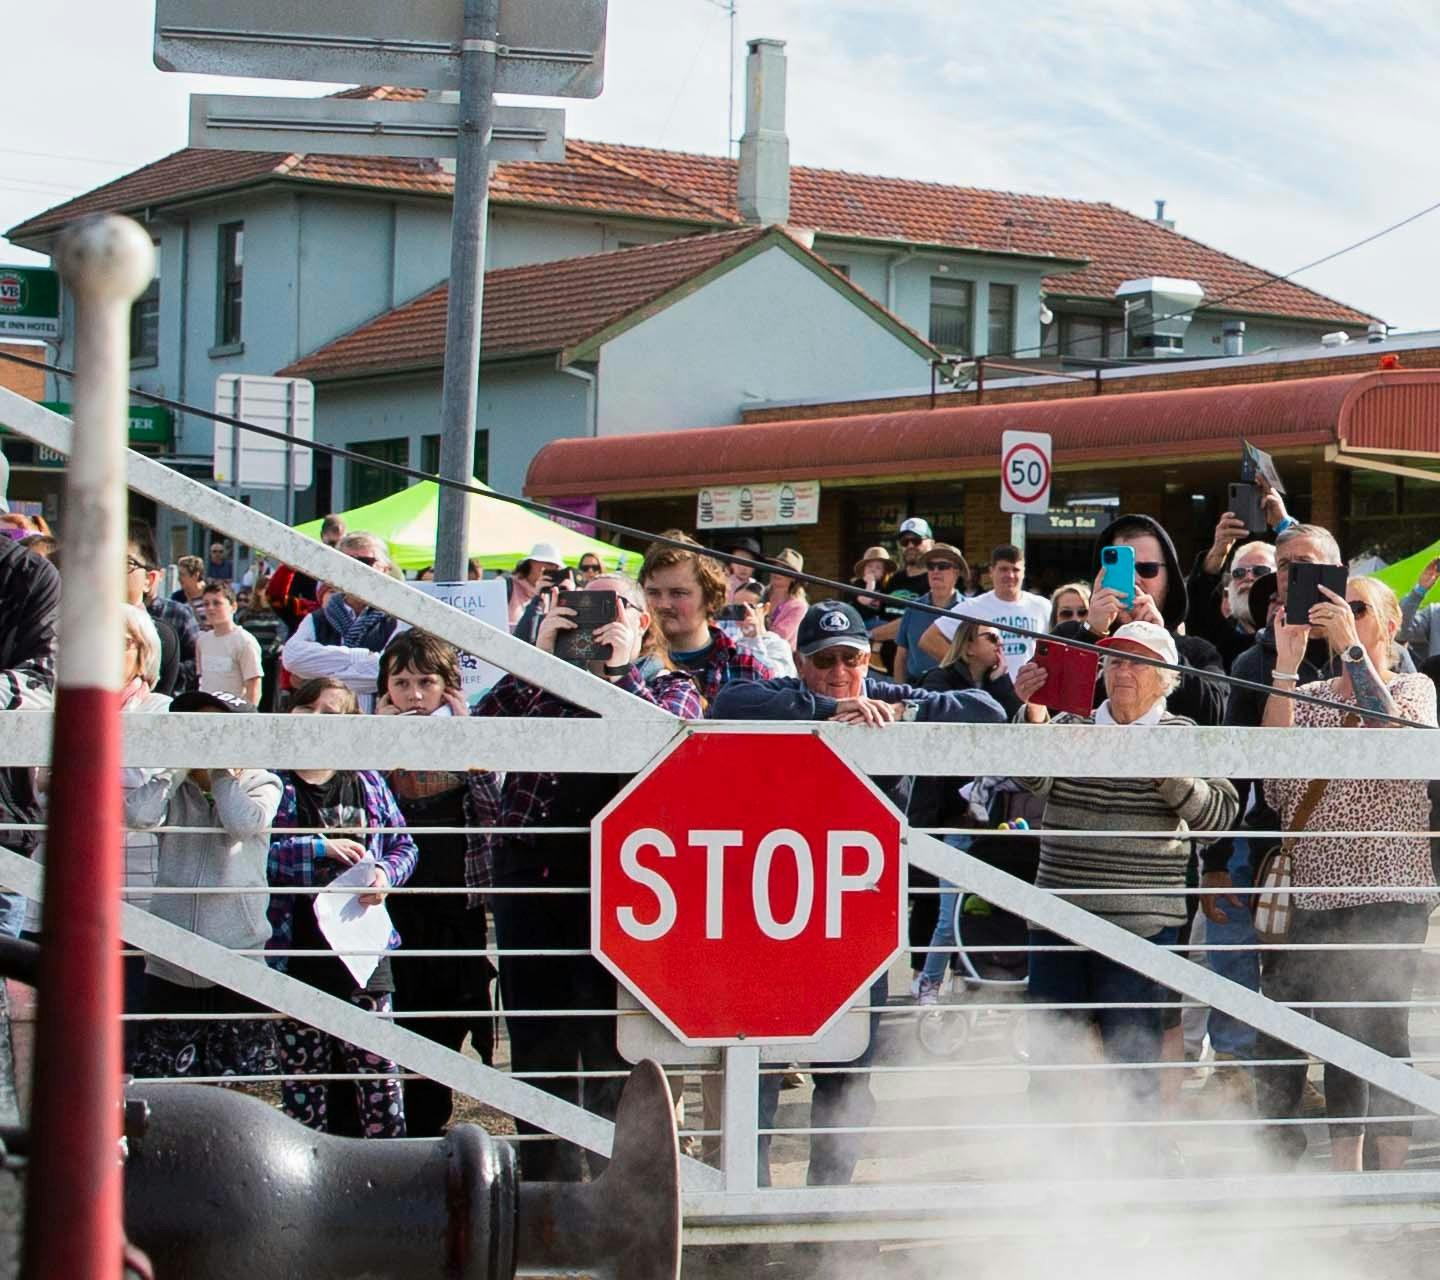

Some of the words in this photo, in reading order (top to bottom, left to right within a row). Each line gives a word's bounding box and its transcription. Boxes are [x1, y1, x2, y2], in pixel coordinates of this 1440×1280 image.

[0, 285, 19, 297] VB
[8, 321, 25, 330] INN
[27, 322, 57, 332] HOTEL
[1012, 460, 1042, 486] 50
[616, 827, 885, 941] STOP
